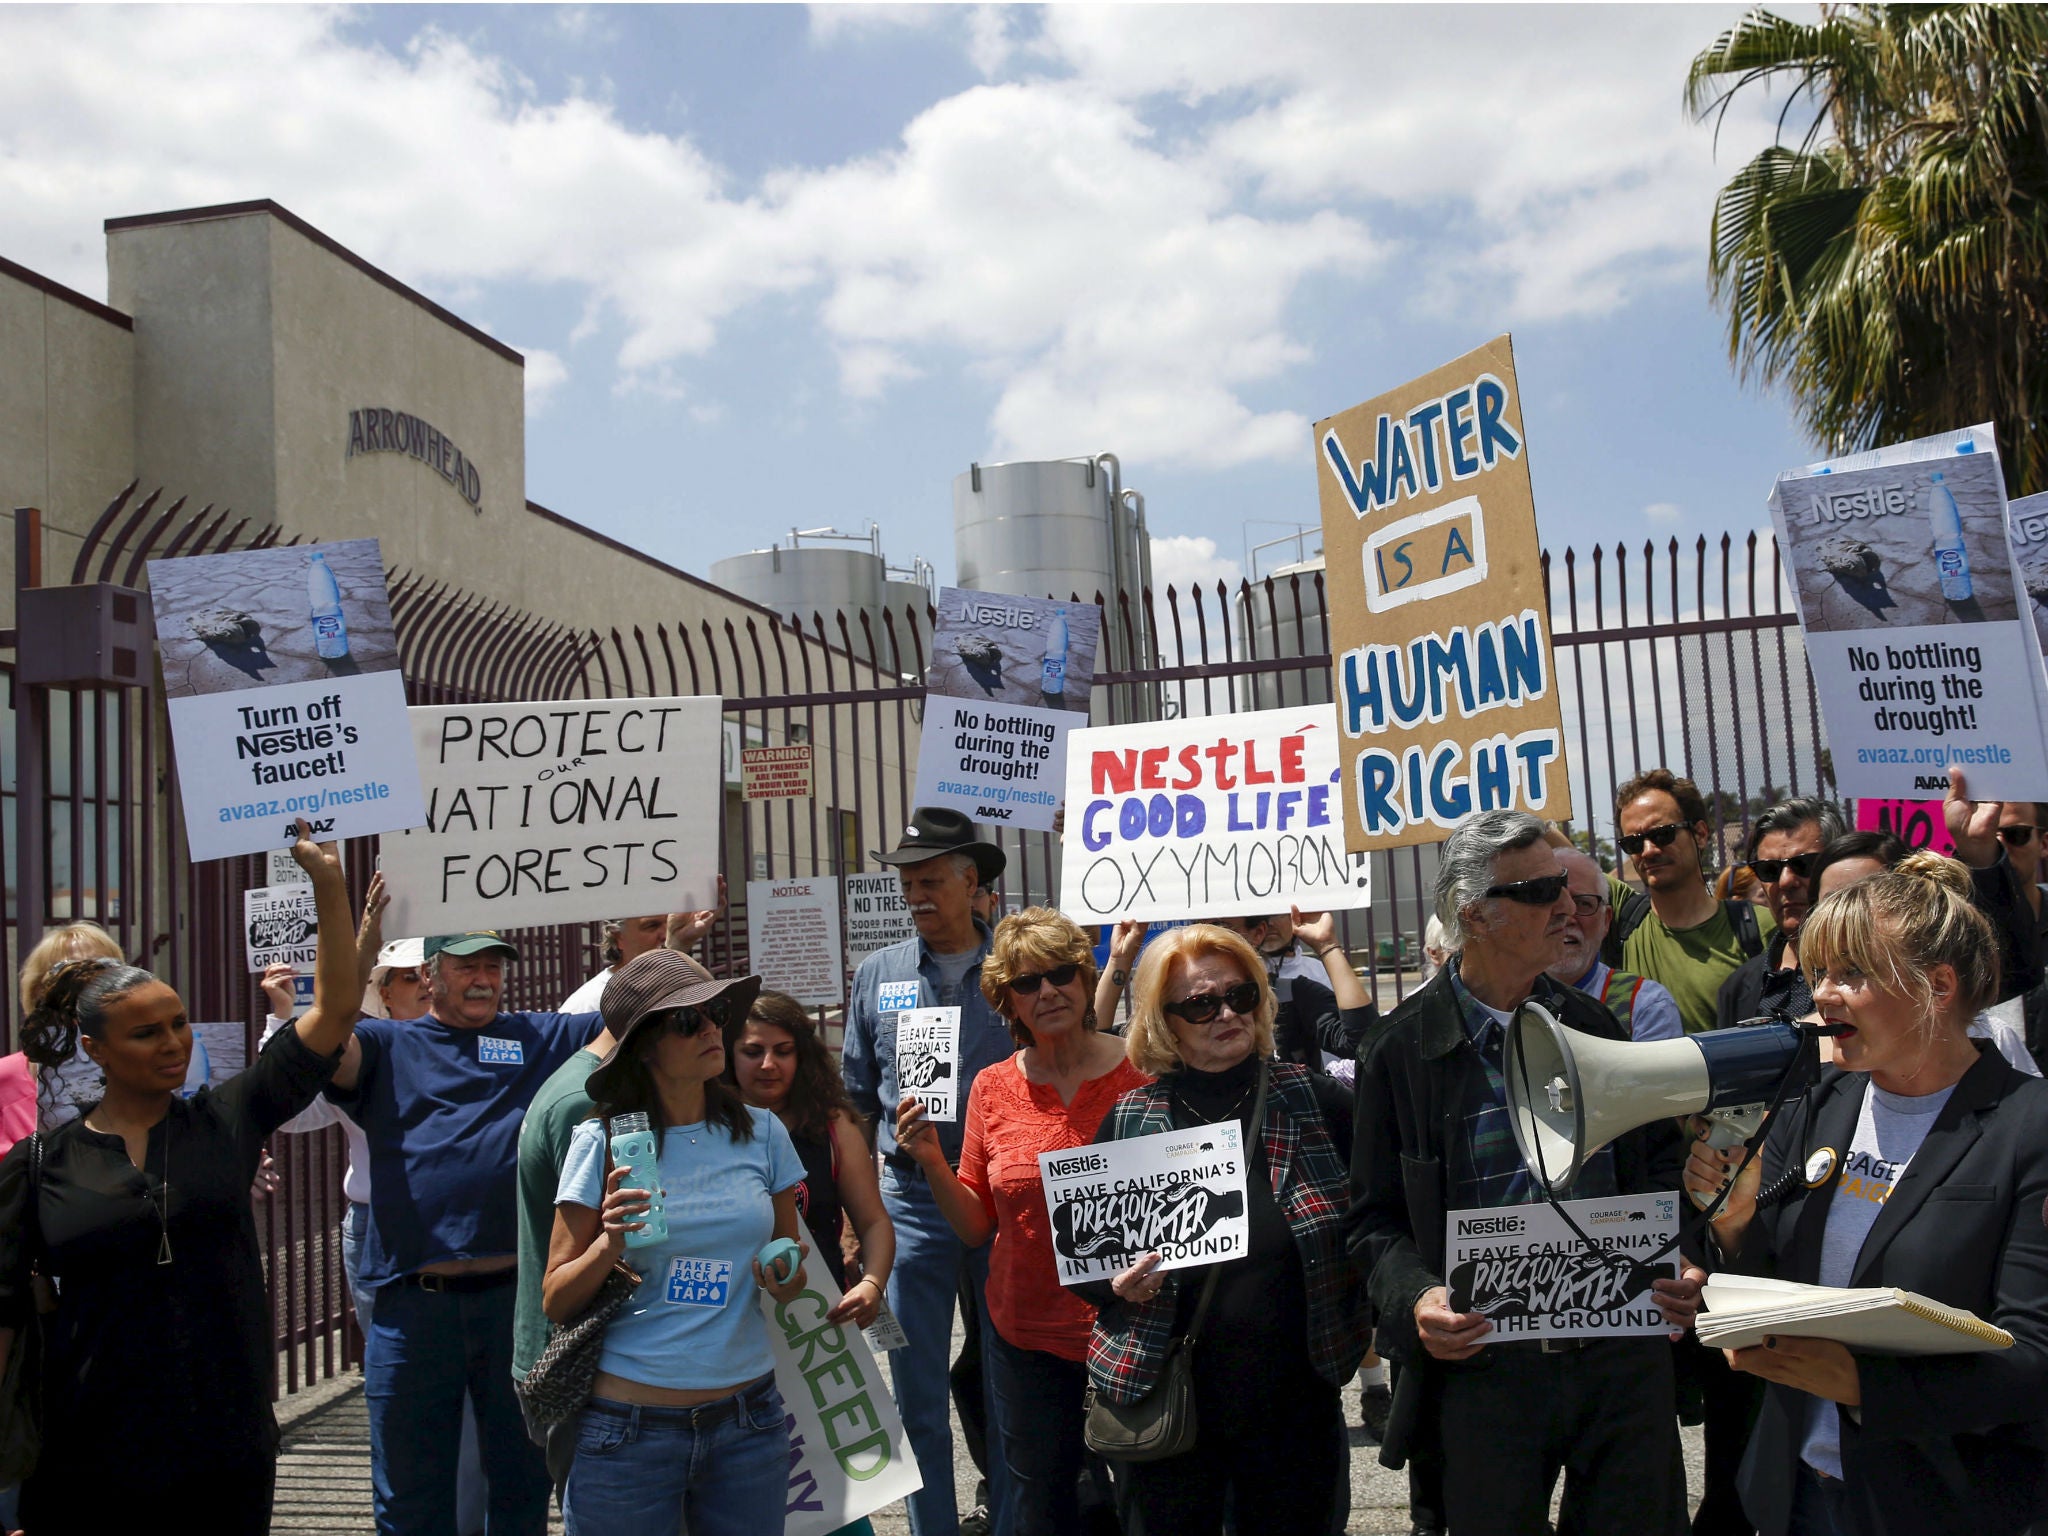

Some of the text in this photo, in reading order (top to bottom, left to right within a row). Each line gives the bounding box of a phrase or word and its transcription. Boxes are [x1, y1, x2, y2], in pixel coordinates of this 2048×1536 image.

[346, 408, 481, 506] ARROWHEAD
[1323, 374, 1522, 519] WATER
[1377, 527, 1473, 593] IS A
[1848, 642, 1983, 673] No bottling
[1340, 610, 1545, 737] HUMAN
[1859, 673, 1983, 706] during the
[238, 695, 341, 730] Turn off
[1874, 704, 1978, 736] drought!
[440, 708, 682, 764] PROTECT
[954, 710, 1055, 742] No bottling
[744, 748, 809, 762] WARNING
[955, 732, 1049, 760] during the
[1857, 743, 2012, 768] avaaz.org/nestle
[252, 751, 346, 785] faucet!
[538, 757, 586, 781] OUR
[745, 762, 809, 773] THESE PREMISES
[772, 771, 799, 779] UNDER
[960, 755, 1039, 781] drought!
[748, 788, 807, 798] SURVEILLANCE
[759, 781, 782, 789] HOUR
[783, 779, 808, 787] VIDEO
[937, 781, 1055, 806] avaaz.org/nestle
[1357, 730, 1557, 834] RIGHT
[1914, 776, 1950, 790] AVAA
[219, 782, 390, 823] avaaz.org/nestle
[975, 806, 1013, 820] AVAAZ
[1082, 768, 1341, 852] GOOD LIFE
[274, 855, 299, 868] ENTE
[442, 840, 678, 902] FORESTS
[848, 877, 897, 895] PRIVATE
[1082, 835, 1368, 914] OXYMORON!
[773, 885, 812, 897] NOTICE
[264, 898, 303, 912] LEAVE
[854, 895, 909, 913] NO TRES
[849, 929, 913, 941] IMPRISONMENT
[883, 918, 903, 928] FINE
[881, 1000, 904, 1009] TAP
[905, 1027, 935, 1041] LEAVE
[483, 1051, 509, 1060] TAP
[1220, 1128, 1237, 1136] Sum
[1165, 1142, 1194, 1153] COURAGE
[1166, 1148, 1198, 1159] CAMPAIGN
[1053, 1161, 1236, 1204] LEAVE CALIFORNIA'S
[1590, 1210, 1622, 1219] COURAGE
[1655, 1199, 1673, 1207] Sum
[1071, 1190, 1167, 1243] PRECIOUS
[1122, 1190, 1208, 1250] WATER
[1590, 1216, 1626, 1225] CAMPAIGN
[1066, 1233, 1239, 1276] IN THE ROUND!
[1457, 1233, 1668, 1262] LEAVE CALIFORNIA'S
[675, 1269, 710, 1280] BACK
[676, 1260, 712, 1271] TAKE
[674, 1279, 710, 1288] THE
[1471, 1256, 1583, 1302] PRECIOUS
[1527, 1265, 1632, 1313] WATER
[673, 1286, 708, 1301] TAP
[1493, 1315, 1540, 1333] THE
[774, 1289, 892, 1482] GREED
